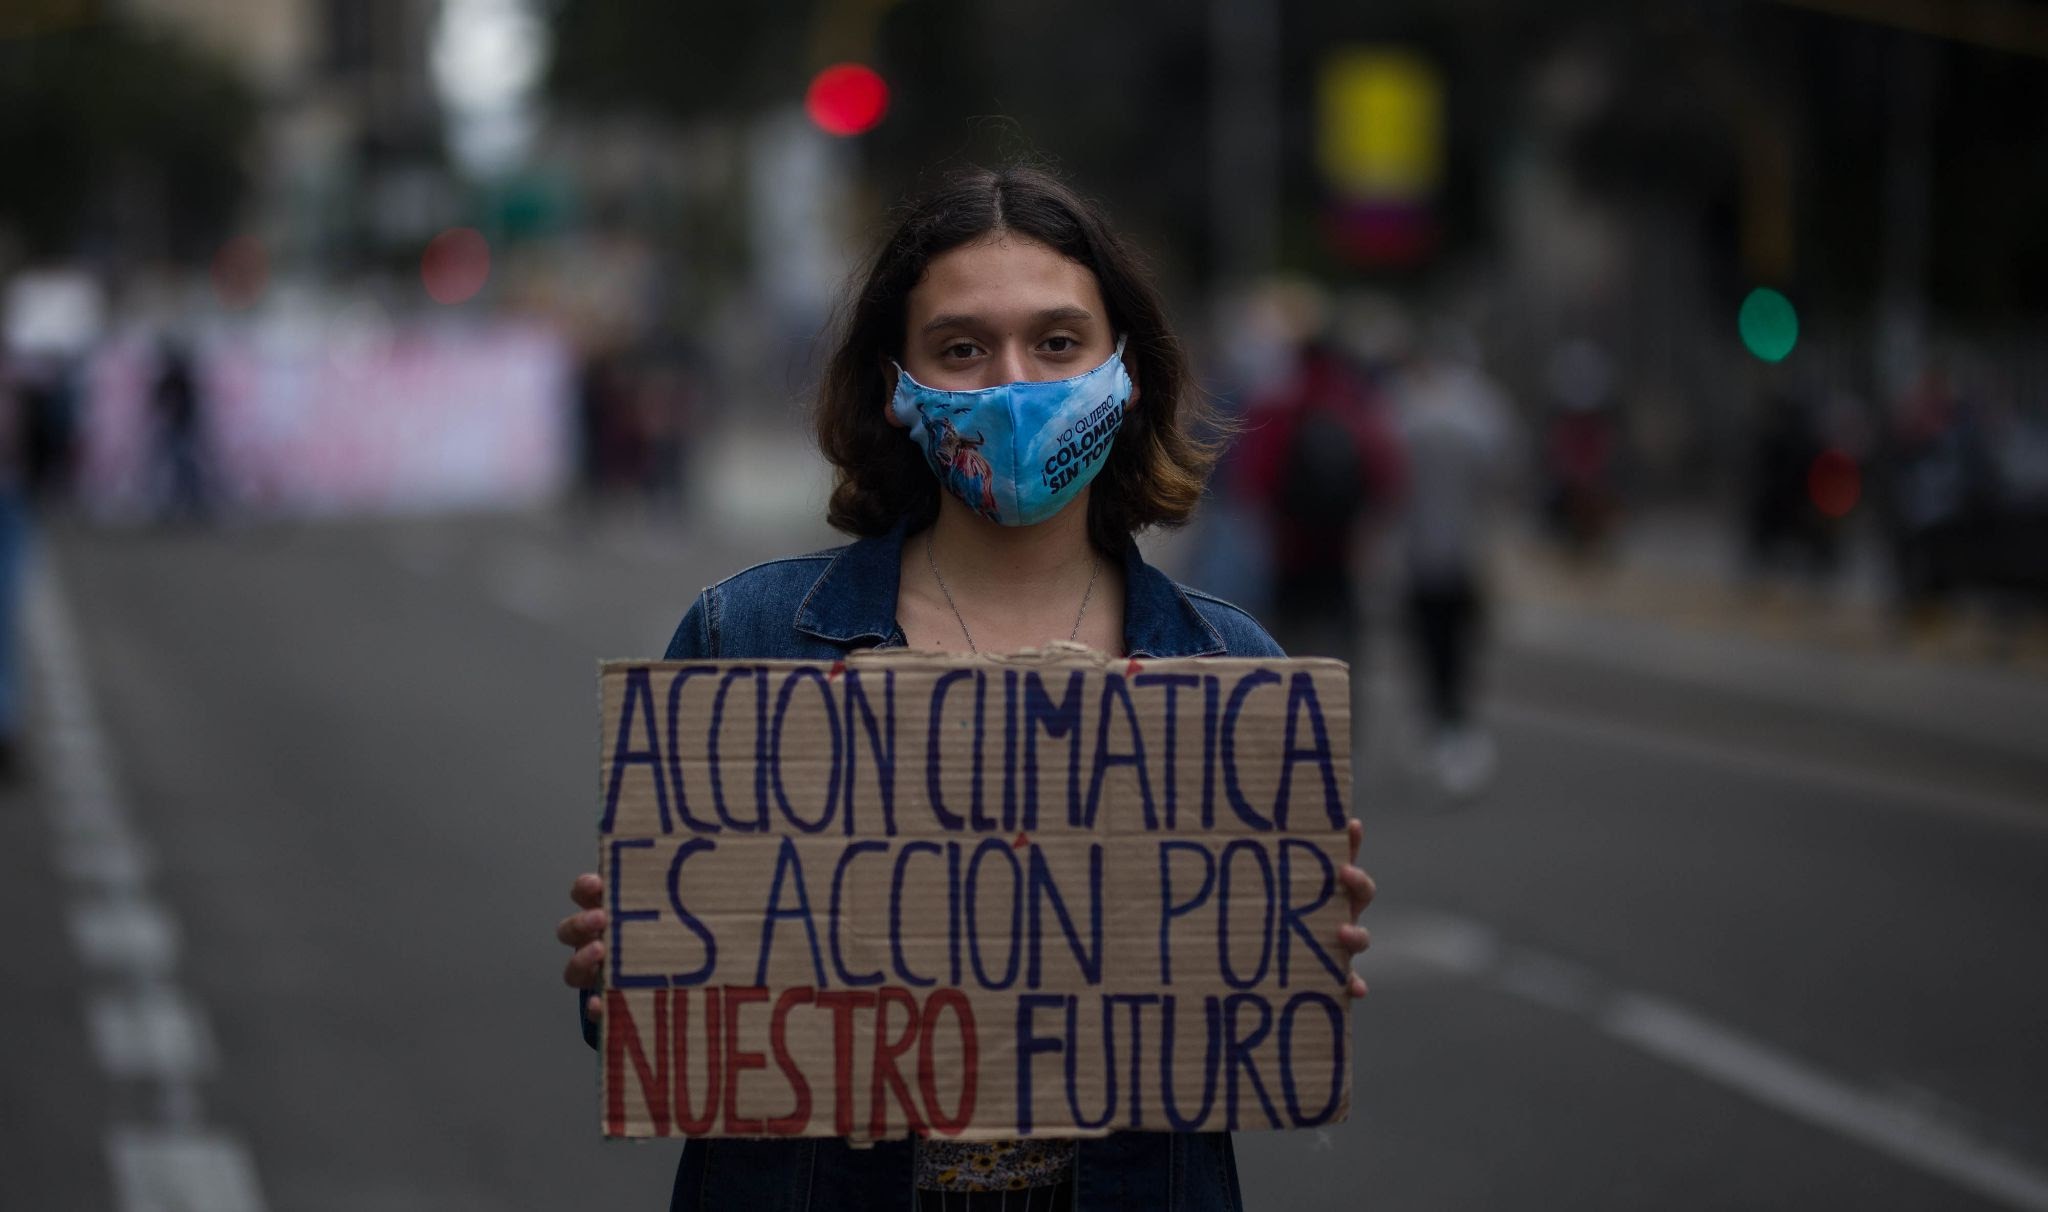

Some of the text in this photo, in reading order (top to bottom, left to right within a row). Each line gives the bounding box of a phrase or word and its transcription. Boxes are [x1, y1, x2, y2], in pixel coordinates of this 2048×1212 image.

[1049, 461, 1079, 495] SIN
[1057, 395, 1114, 446] YO QUIERO
[602, 660, 1347, 836] ACCIÓN CLIMÁTICA
[610, 834, 1348, 990] ES ACCIÓN POR
[606, 985, 1345, 1139] NUESTRO FUTURO
